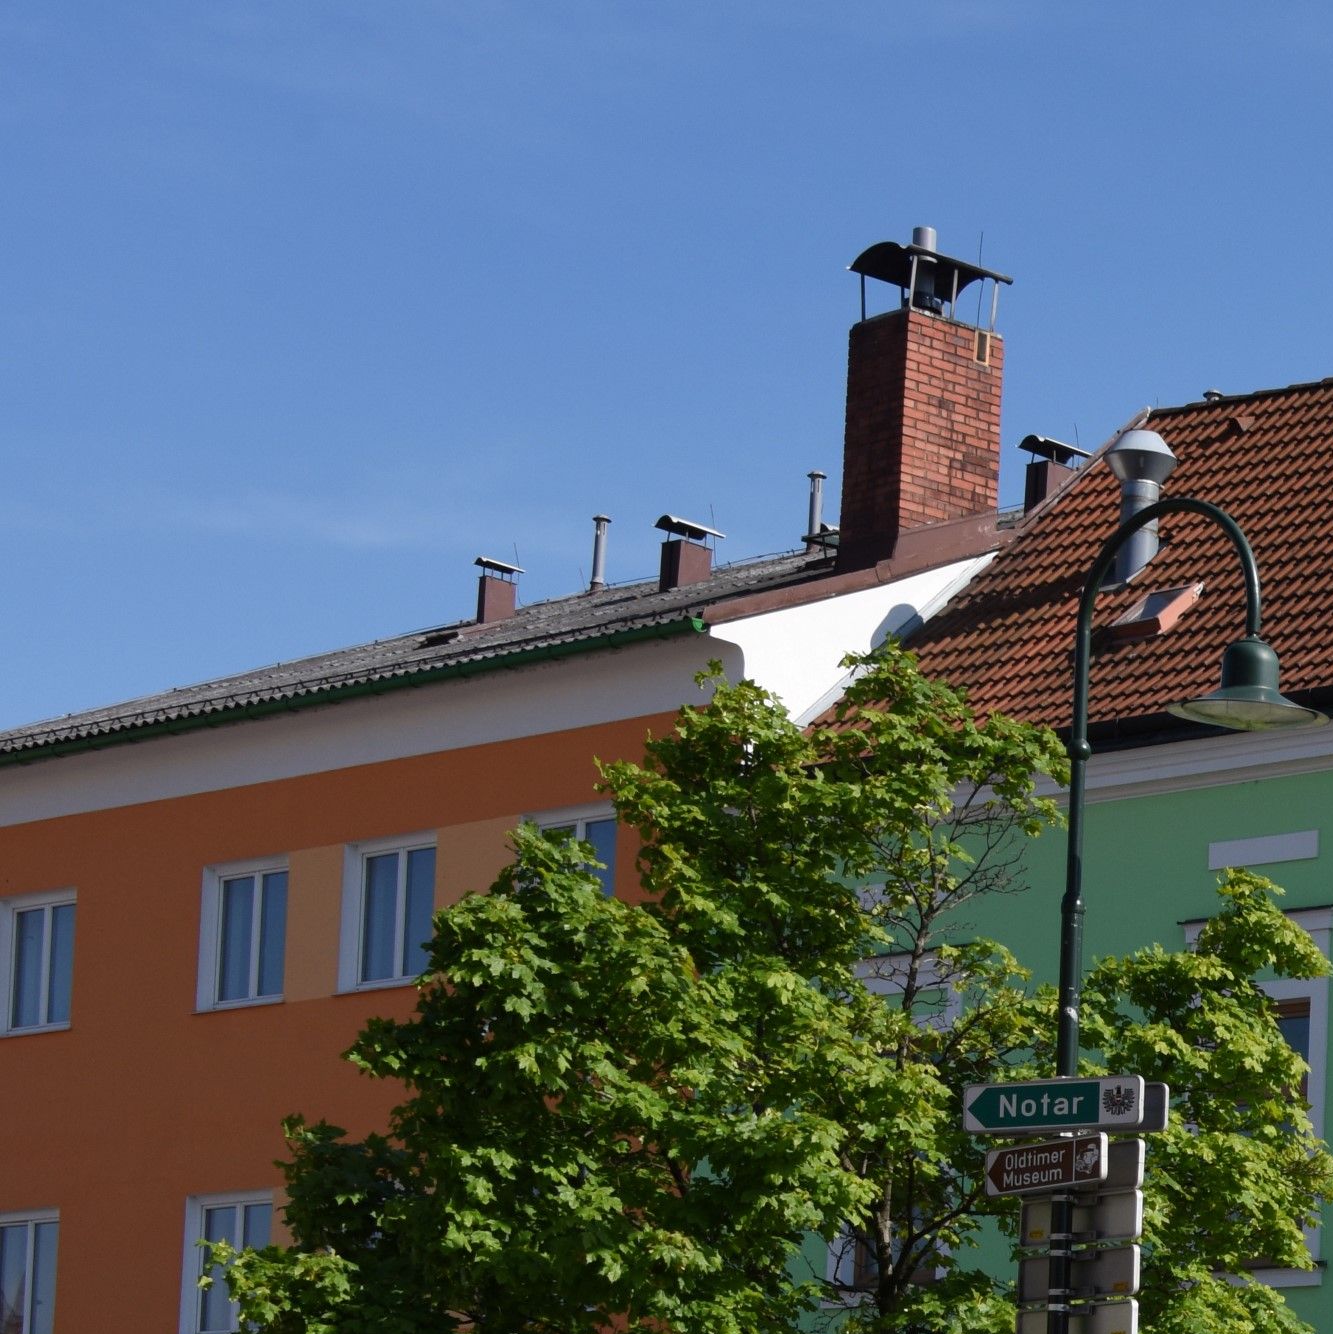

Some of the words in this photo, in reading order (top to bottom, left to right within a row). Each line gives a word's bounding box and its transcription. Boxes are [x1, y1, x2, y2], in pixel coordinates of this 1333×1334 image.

[999, 1093, 1085, 1118] Notar
[1005, 1149, 1066, 1170] Oldtimer
[1003, 1168, 1063, 1188] Museum
